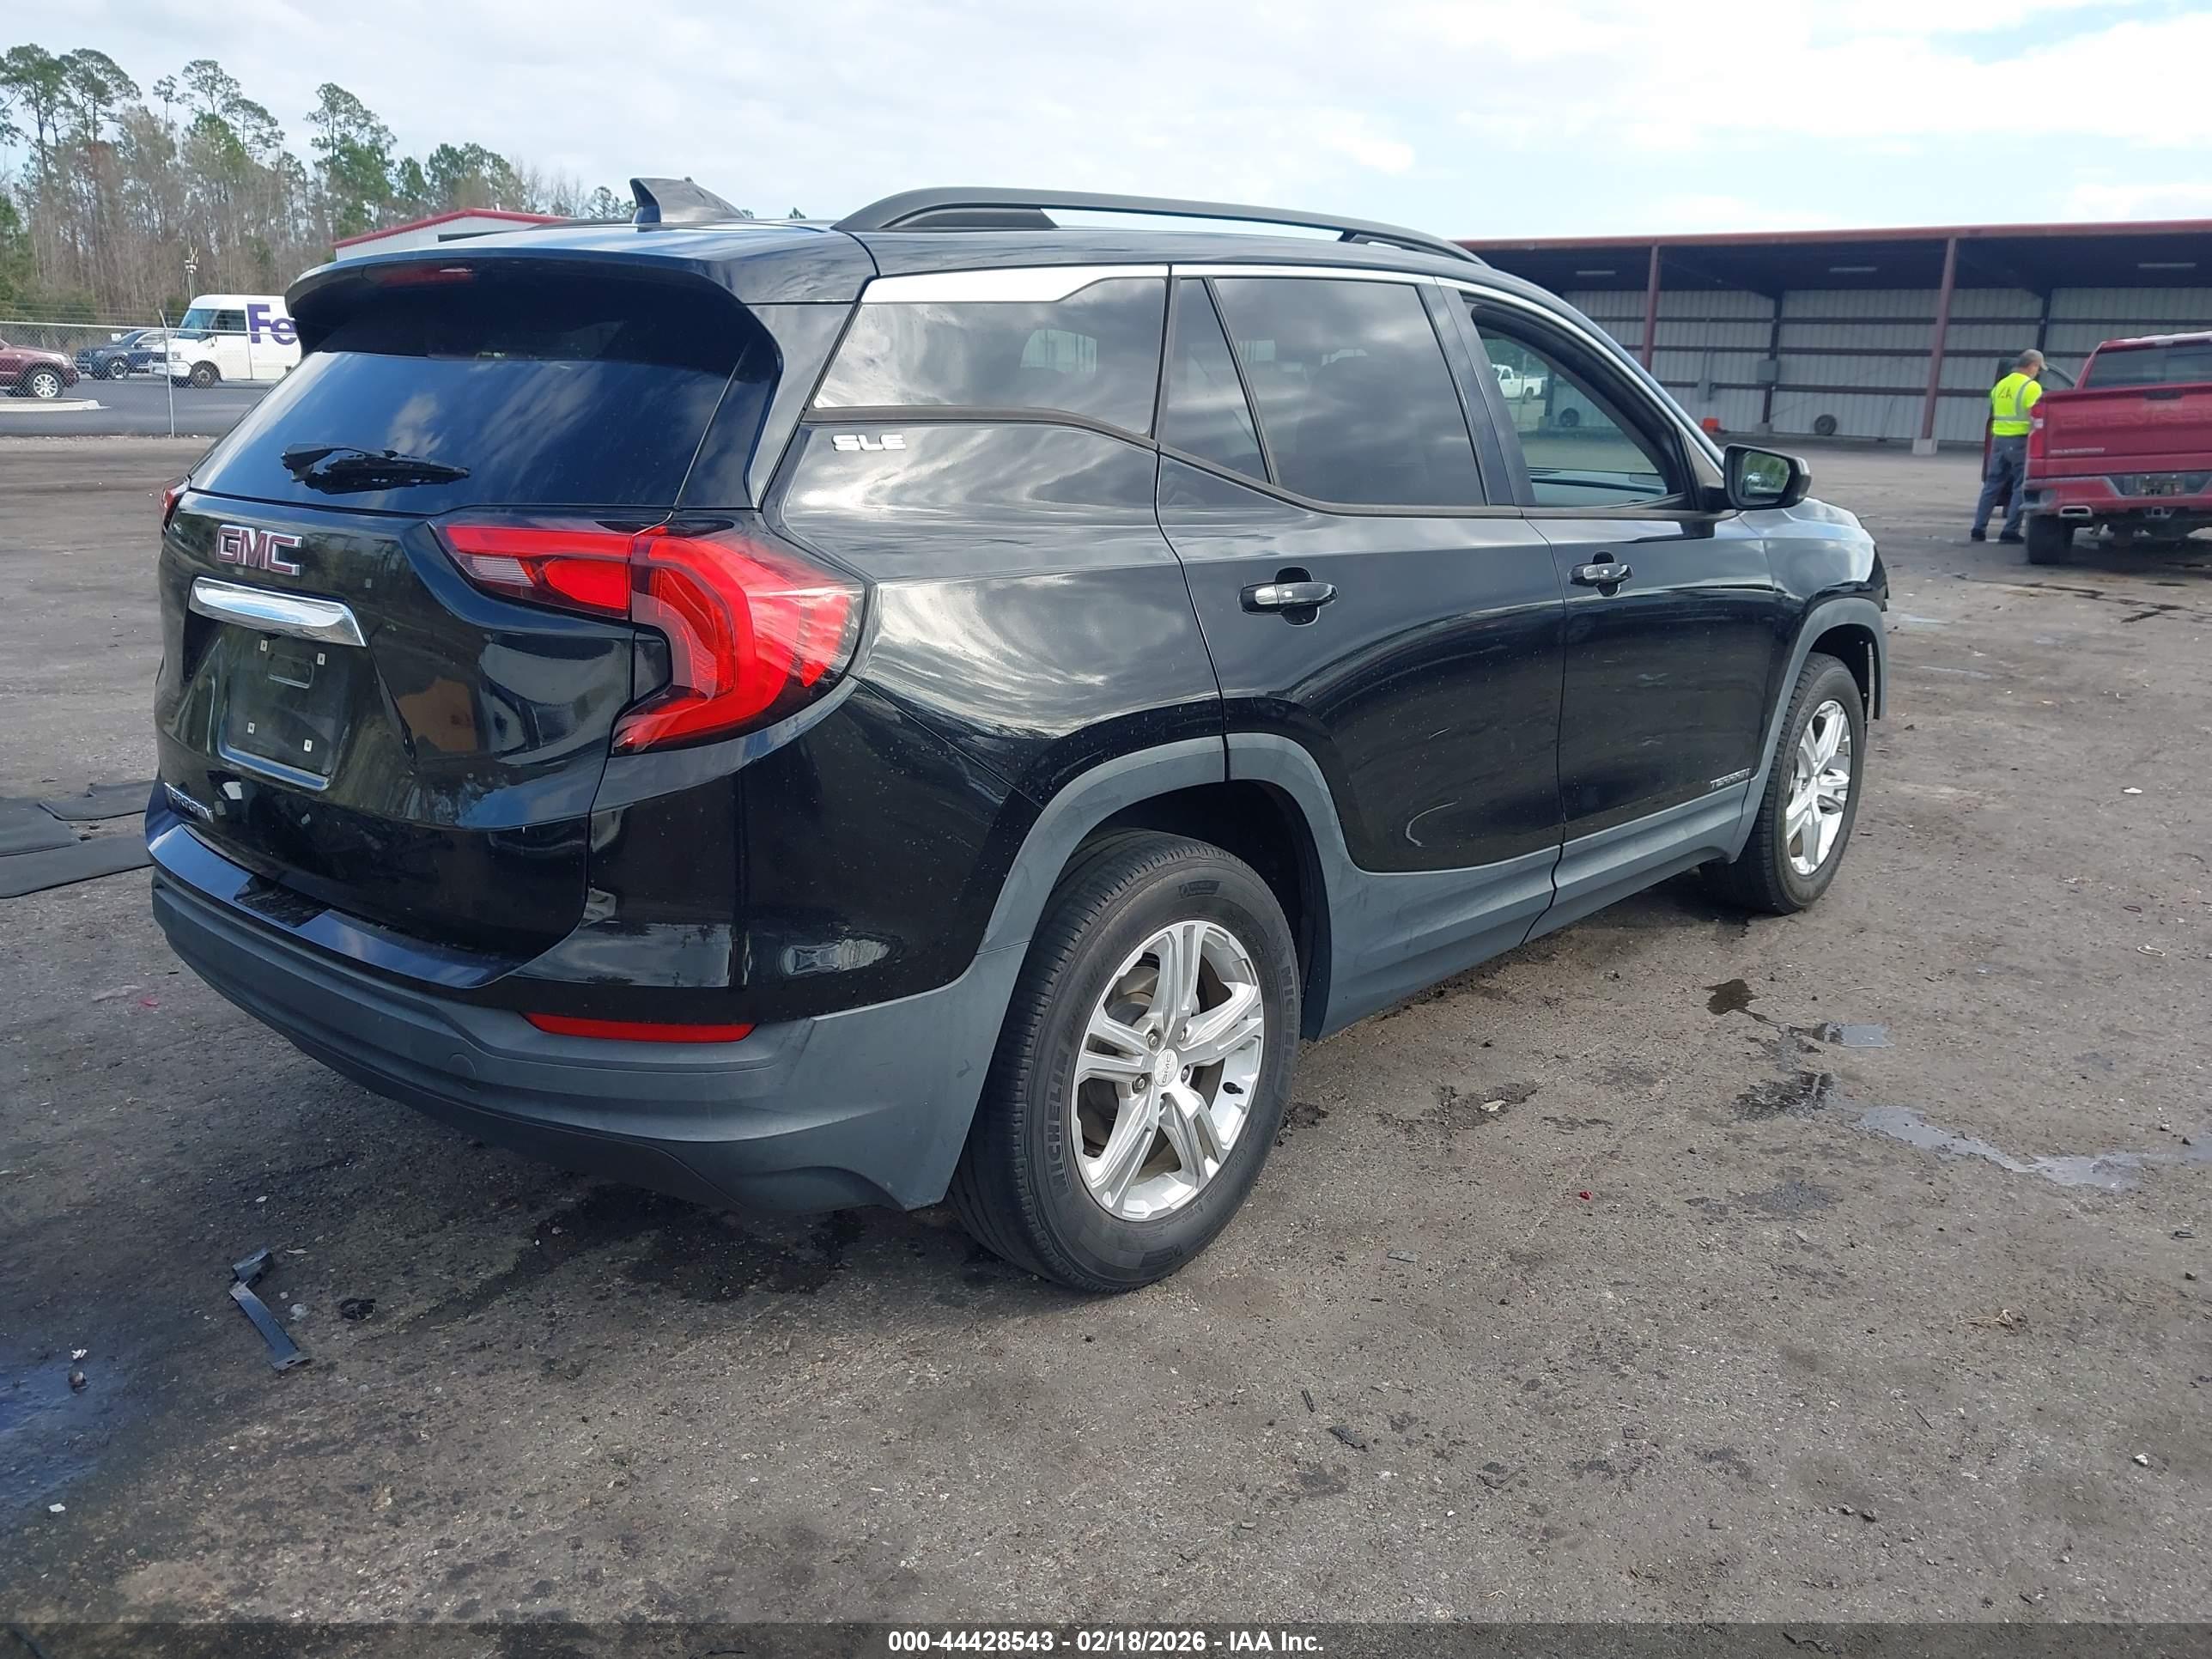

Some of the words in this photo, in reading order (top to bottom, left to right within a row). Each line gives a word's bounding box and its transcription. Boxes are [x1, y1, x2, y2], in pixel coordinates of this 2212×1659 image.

[831, 434, 907, 452] SLE
[216, 524, 302, 576] GMC
[1162, 1052, 1172, 1084] GMC
[1047, 1047, 1071, 1198] MICHELIN
